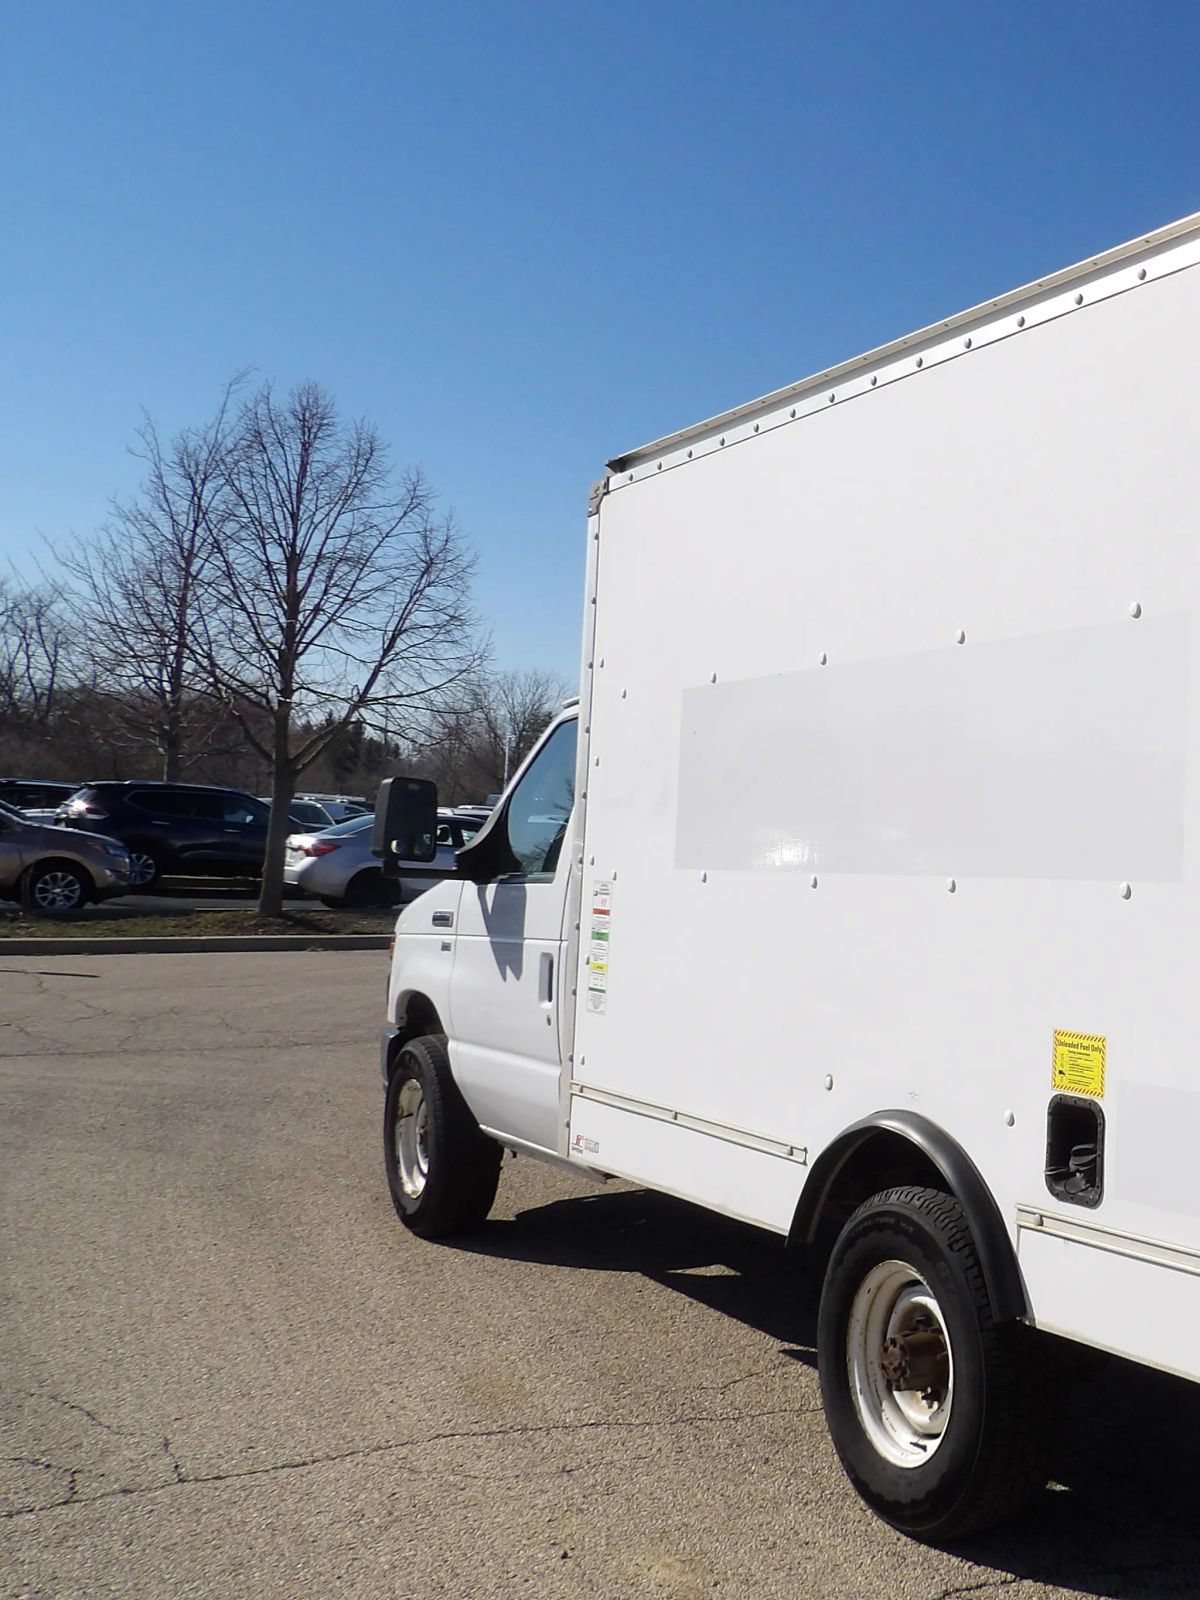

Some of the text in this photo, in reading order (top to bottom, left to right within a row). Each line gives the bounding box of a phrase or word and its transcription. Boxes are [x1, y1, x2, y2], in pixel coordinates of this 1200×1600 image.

[1057, 1039, 1079, 1050] Unleaded
[1080, 1042, 1091, 1051] Fuel
[1091, 1044, 1102, 1054] Only
